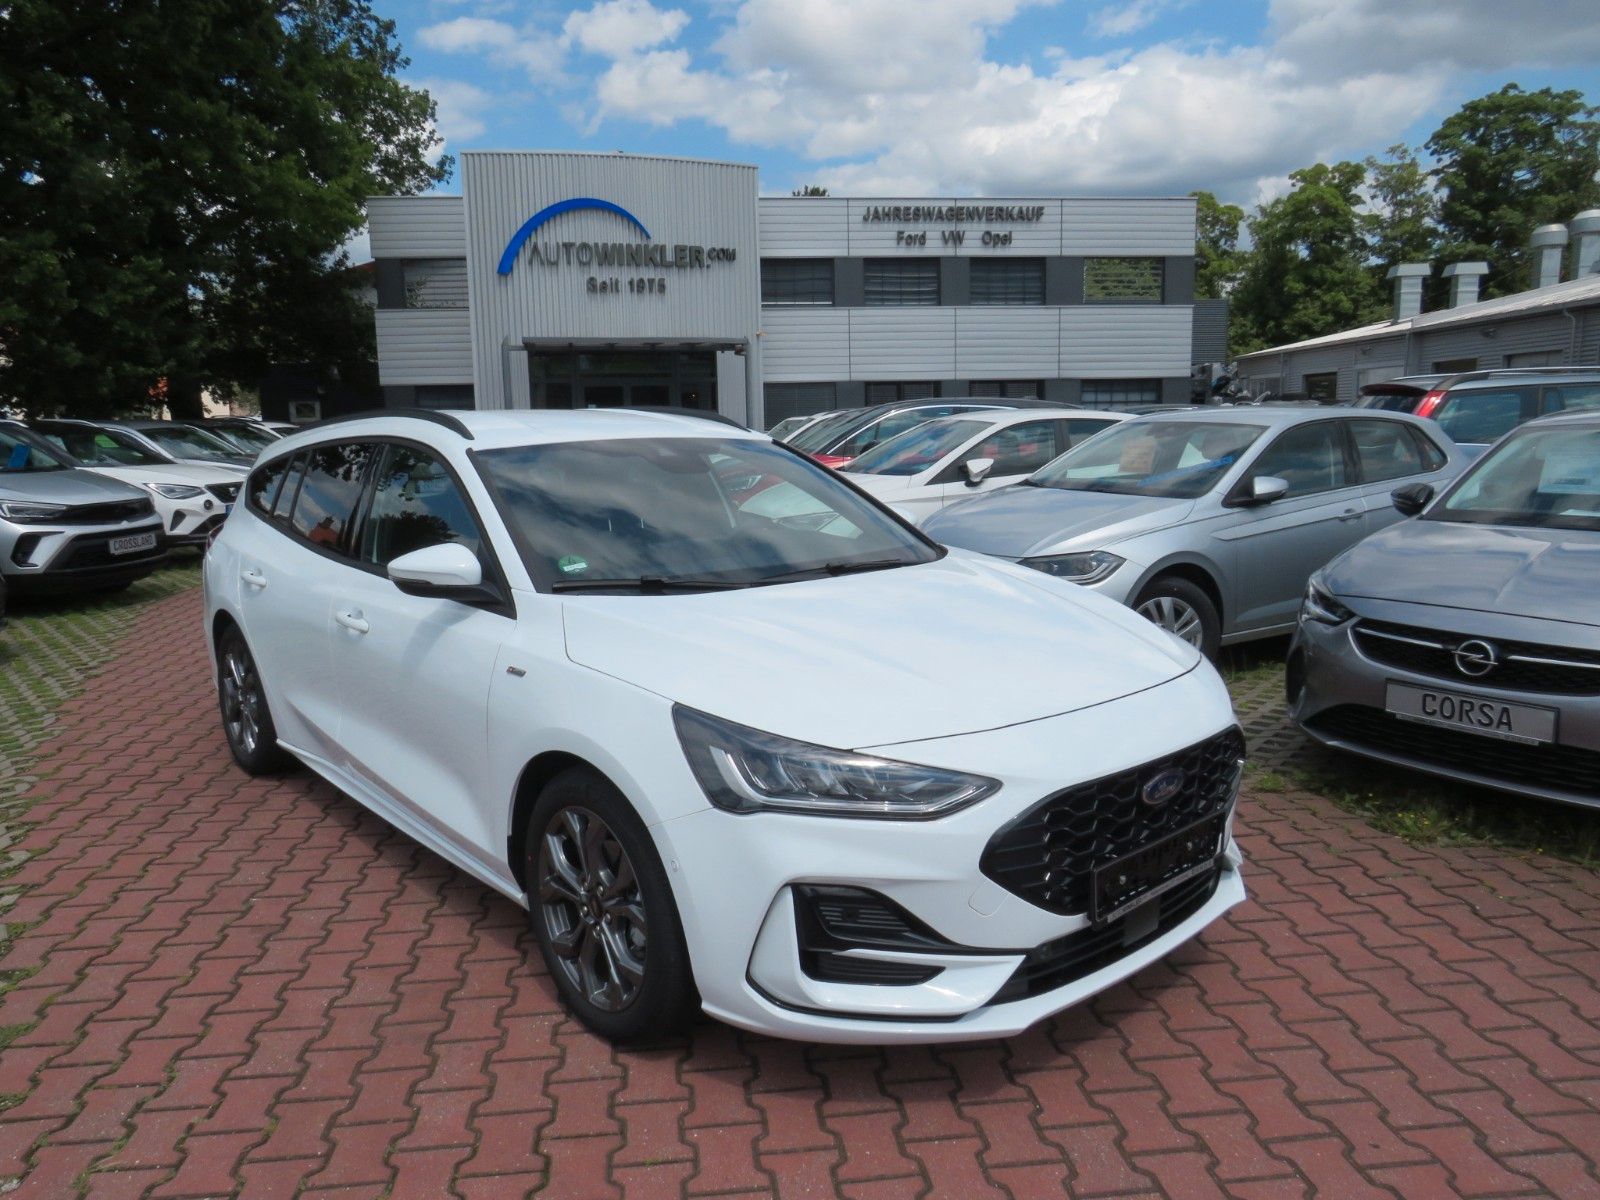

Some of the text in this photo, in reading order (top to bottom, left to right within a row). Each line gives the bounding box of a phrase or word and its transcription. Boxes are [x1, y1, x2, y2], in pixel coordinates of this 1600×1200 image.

[862, 206, 1045, 222] JAHRESWAGENVERKAUF
[896, 230, 1013, 249] Ford VW Opel
[586, 276, 667, 294] Seit 1975
[112, 533, 154, 552] CROSSLAND
[1421, 692, 1513, 732] CORSA
